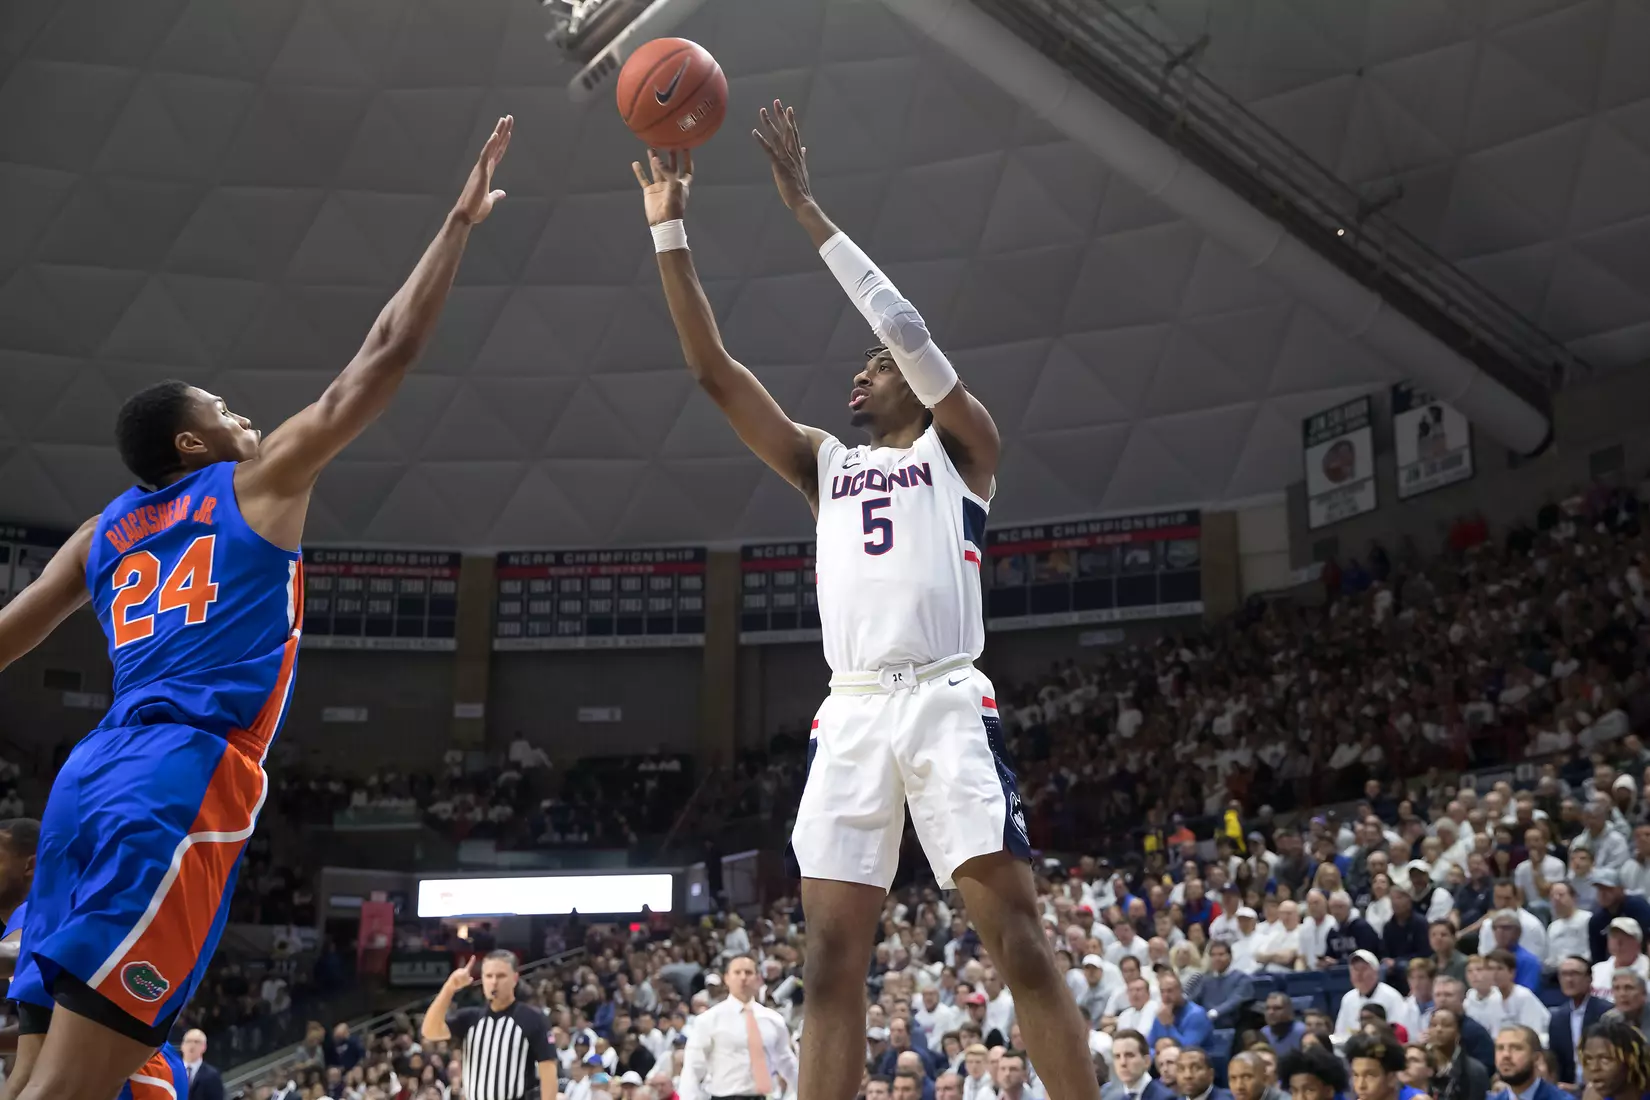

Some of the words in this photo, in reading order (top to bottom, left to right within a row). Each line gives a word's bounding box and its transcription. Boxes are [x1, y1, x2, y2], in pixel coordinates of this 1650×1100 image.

[831, 462, 933, 500] UCONN
[105, 495, 191, 554] BLACKSHEAR
[861, 496, 894, 556] 5
[997, 526, 1045, 542] NCAA
[1052, 513, 1188, 538] CHAMPIONSHIP
[312, 551, 449, 565] CHAMPIONSHIP
[508, 552, 556, 565] NCAA
[563, 550, 695, 564] CHAMPIONSHIP
[752, 545, 799, 558] NCAA
[111, 534, 219, 649] 24
